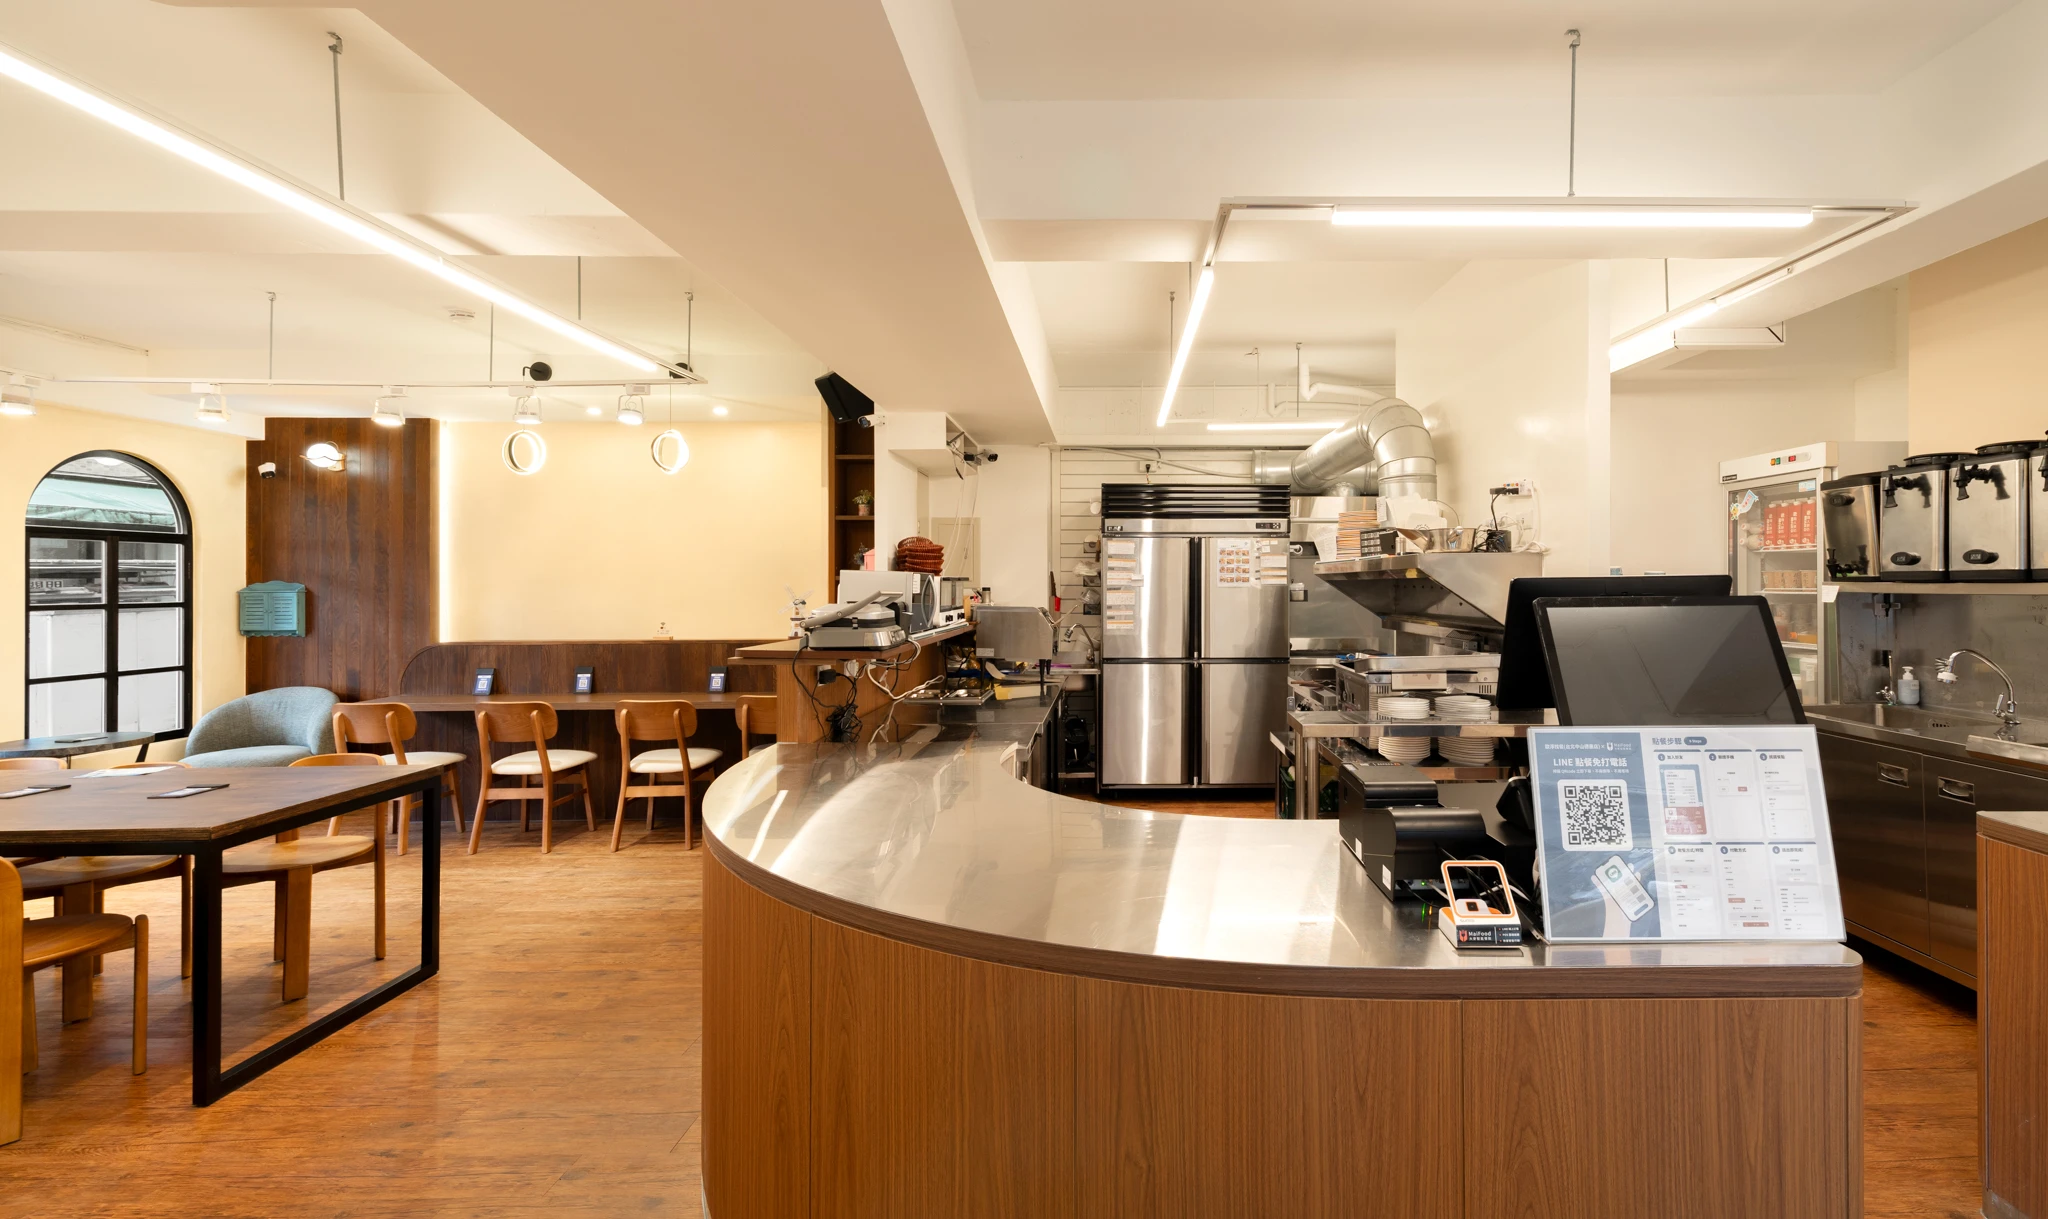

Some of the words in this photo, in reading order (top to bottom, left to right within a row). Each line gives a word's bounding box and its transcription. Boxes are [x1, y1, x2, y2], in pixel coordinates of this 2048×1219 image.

[1651, 737, 1682, 746] 點餐步驟
[1553, 758, 1574, 767] LINE
[1574, 757, 1628, 767] 點餐免打電話
